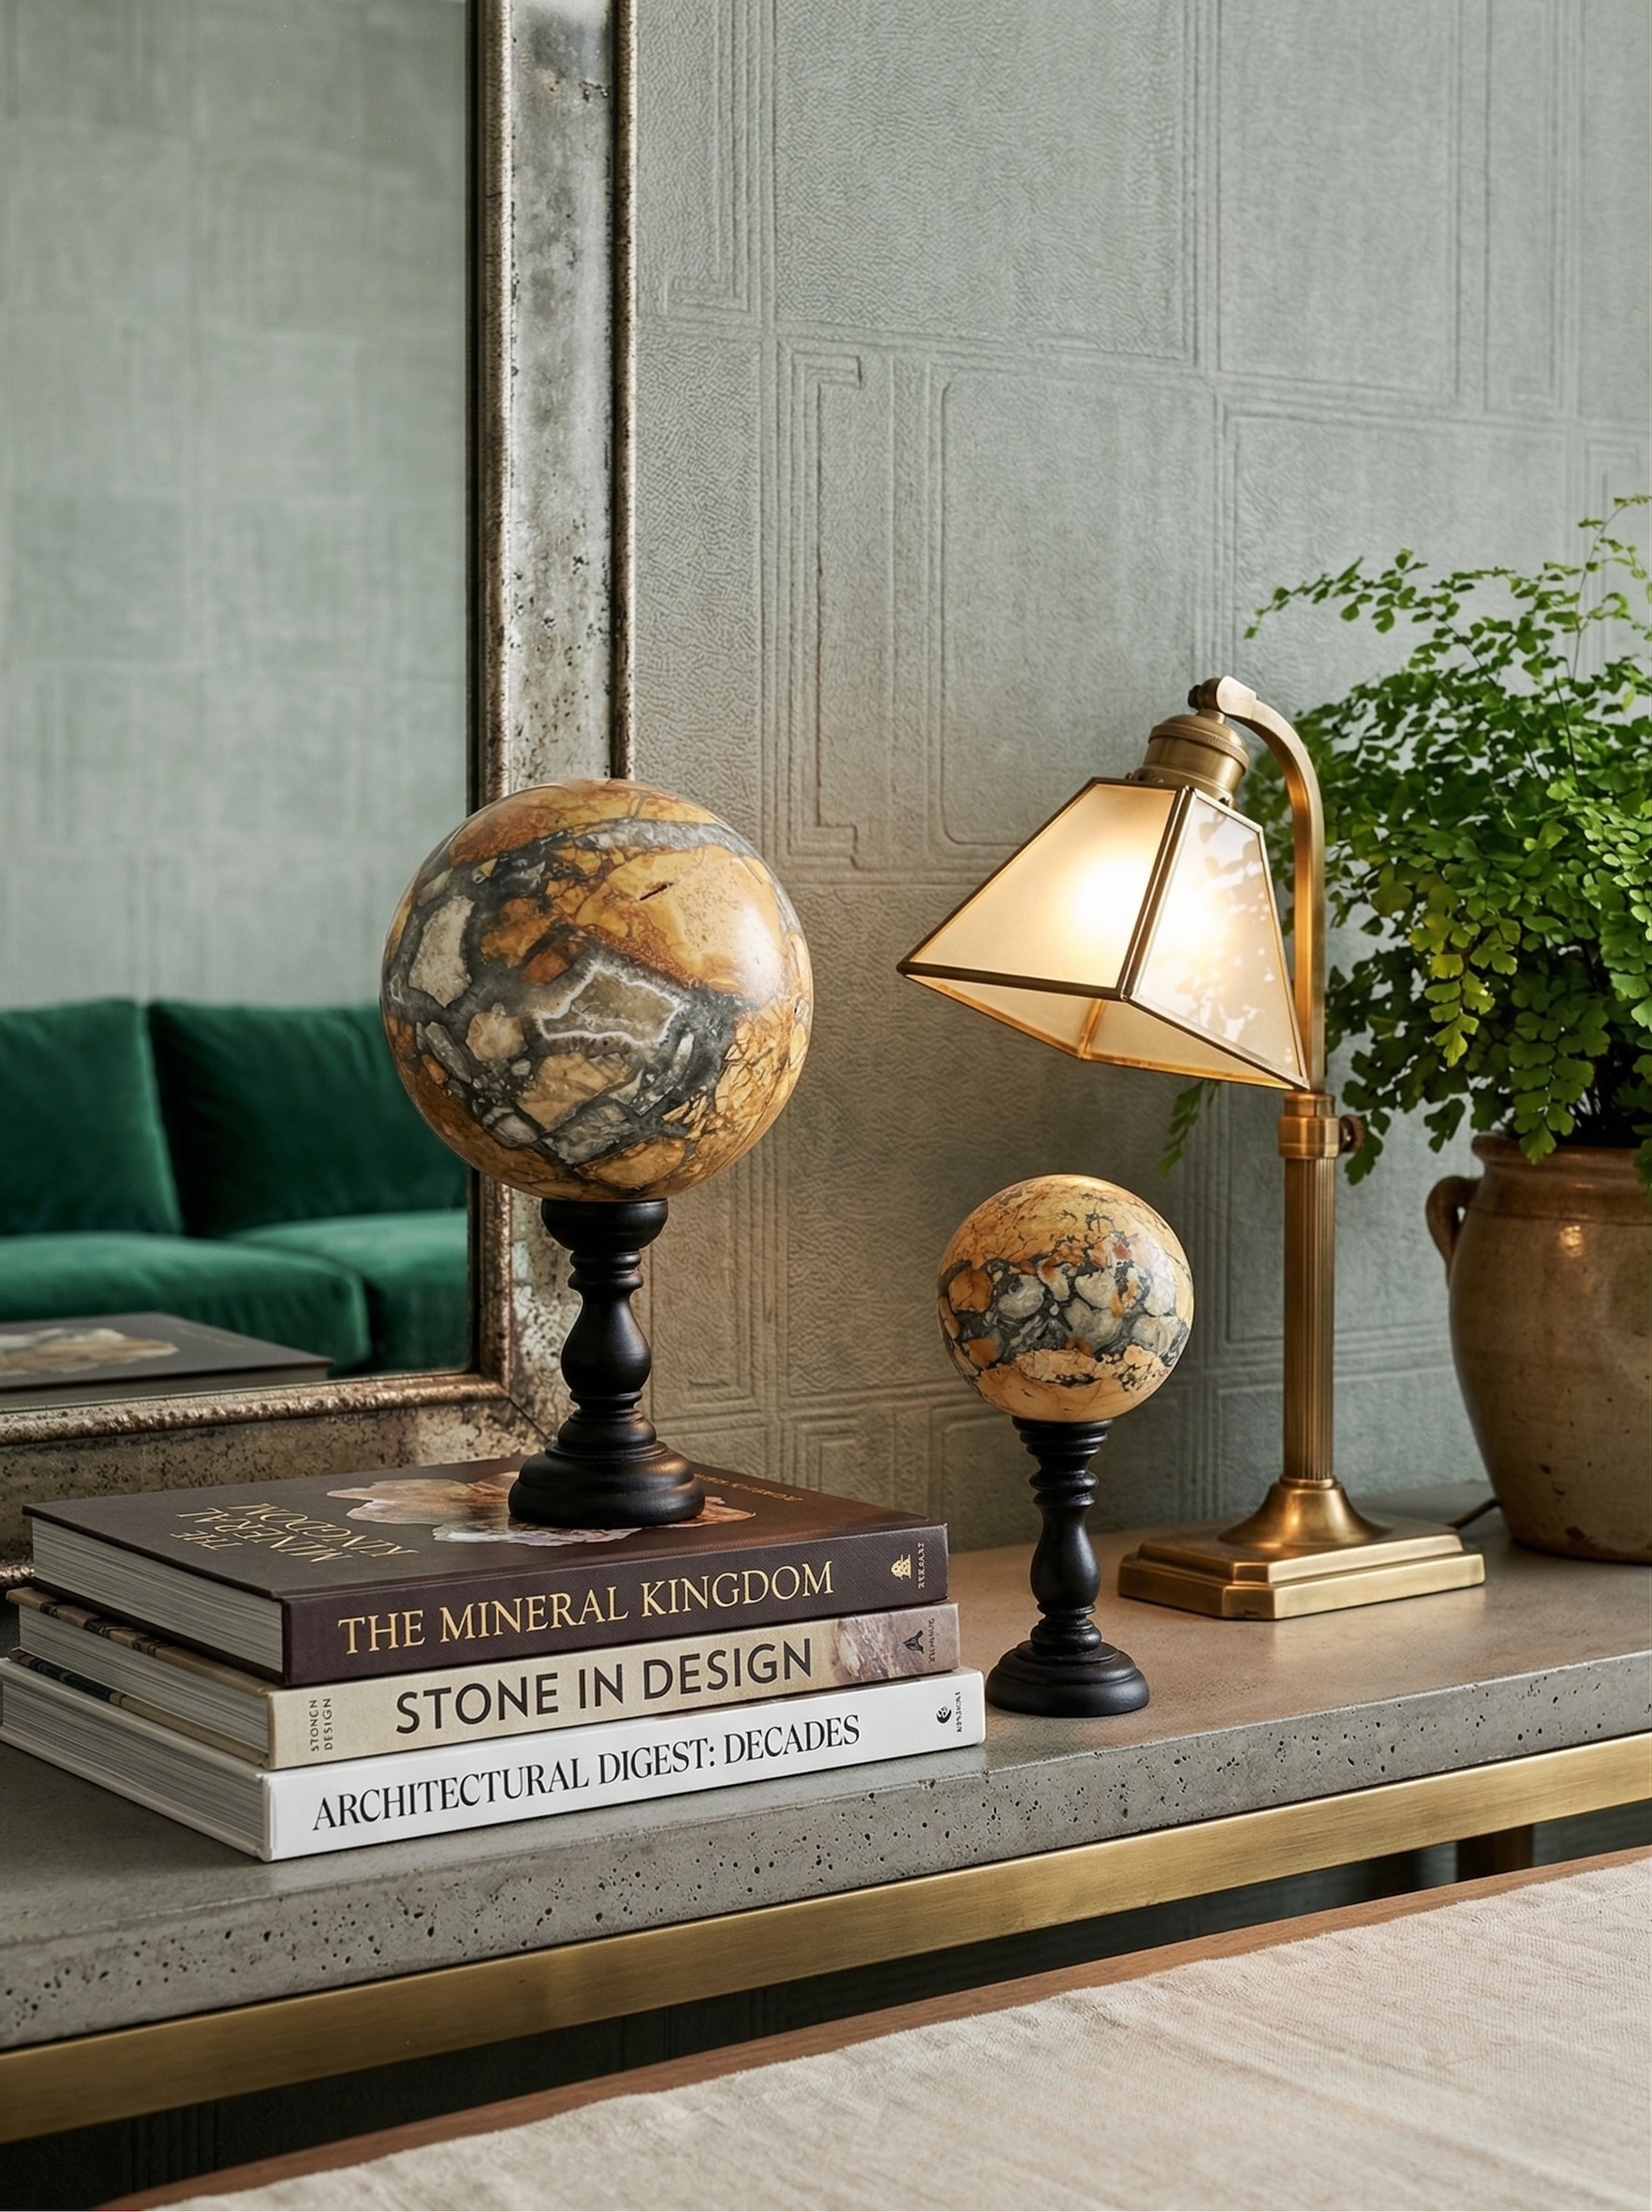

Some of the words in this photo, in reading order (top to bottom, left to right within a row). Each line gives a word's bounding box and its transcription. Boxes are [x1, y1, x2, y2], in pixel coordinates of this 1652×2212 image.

[169, 1529, 243, 1551] THE
[176, 1507, 354, 1563] MINERAL
[226, 1502, 420, 1558] KINGDOM
[338, 1610, 425, 1654] THE
[439, 1586, 629, 1643] MINERAL
[640, 1560, 834, 1617] KINGDOM
[396, 1673, 559, 1734] STONE
[578, 1664, 623, 1709] IN
[644, 1638, 811, 1700] DESIGN
[322, 1698, 333, 1750] DESIGN
[312, 1758, 590, 1831] ARCHITECTURAL
[598, 1738, 715, 1785] DIGEST:
[724, 1715, 860, 1765] DECADES
